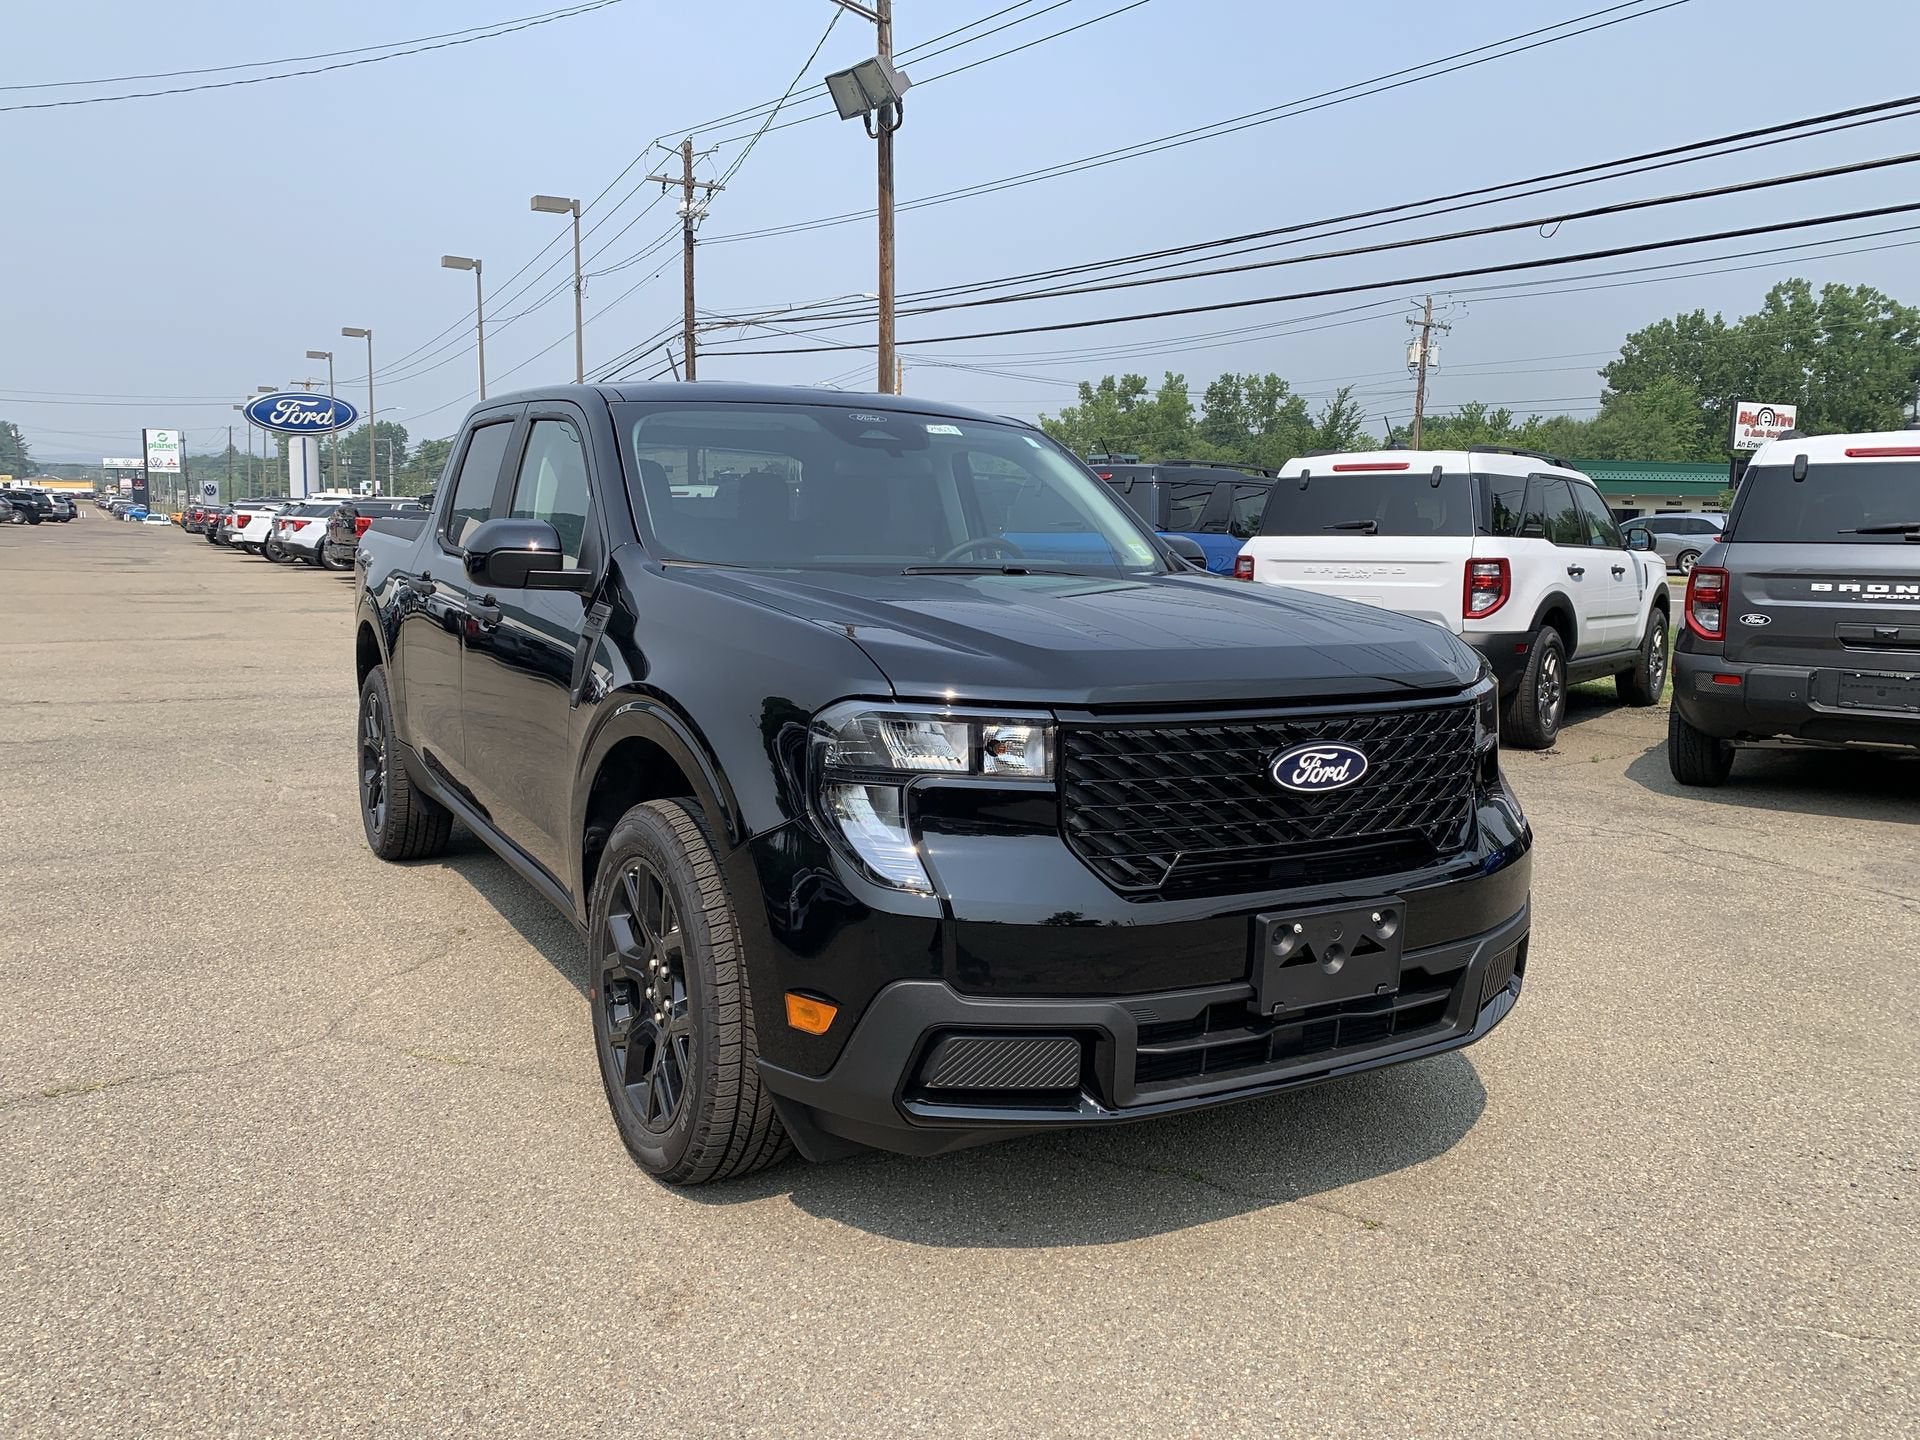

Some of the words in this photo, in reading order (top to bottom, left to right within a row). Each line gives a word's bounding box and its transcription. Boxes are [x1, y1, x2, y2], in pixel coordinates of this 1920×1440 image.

[270, 400, 334, 425] Ford
[1738, 411, 1757, 428] Big
[1775, 413, 1794, 427] Tire
[1750, 429, 1765, 437] Auto
[148, 441, 178, 450] planet
[1736, 440, 1746, 448] An
[1303, 566, 1406, 575] BRONCO
[1811, 583, 1919, 593] BRON
[585, 615, 603, 627] XLT
[1745, 615, 1765, 624] Ford
[1292, 752, 1352, 785] Ford
